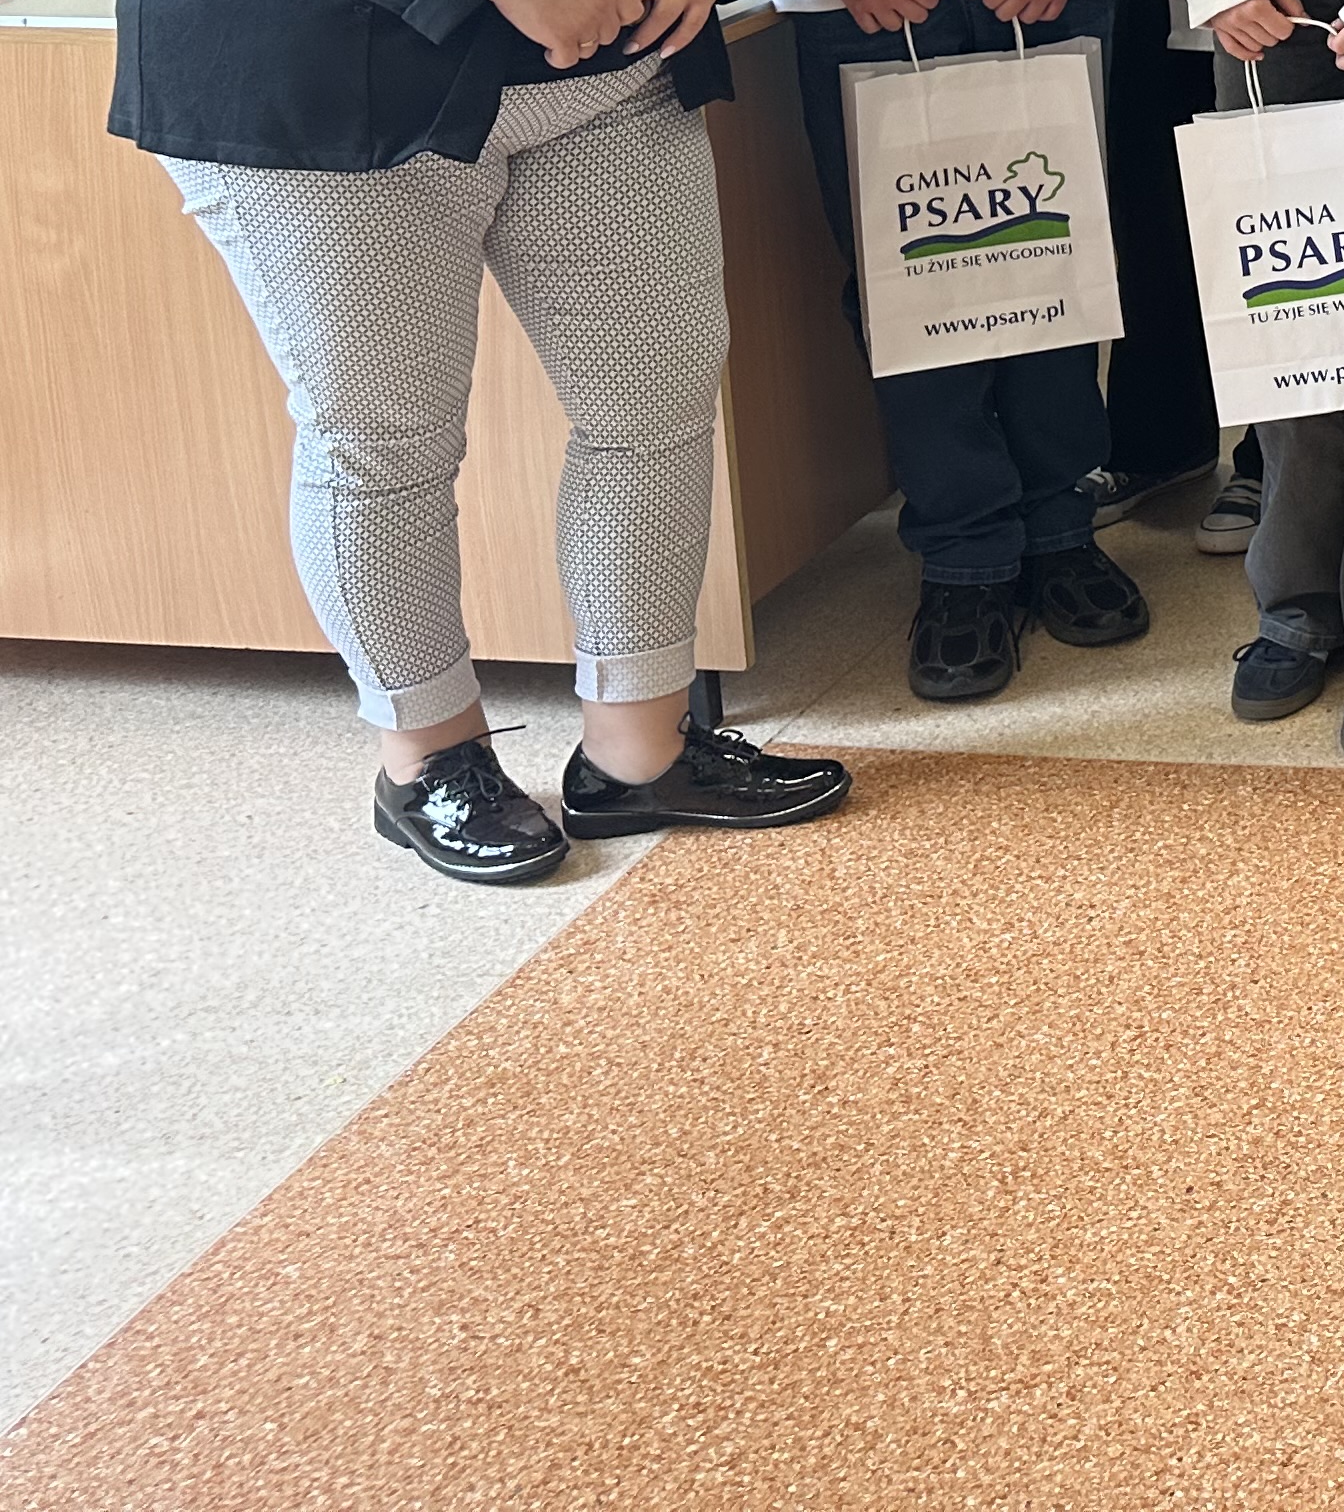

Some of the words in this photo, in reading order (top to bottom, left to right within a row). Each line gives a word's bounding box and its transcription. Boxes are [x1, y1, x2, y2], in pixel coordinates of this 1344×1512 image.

[895, 162, 993, 194] GMINA
[897, 183, 1045, 232] PSARY
[1236, 204, 1336, 235] GMINA
[904, 263, 924, 277] TU
[927, 256, 958, 274] ŻYJE
[961, 254, 982, 270] SIĘ
[985, 243, 1073, 265] WYGODNIEJ
[924, 299, 1066, 336] www.psary.pl
[1248, 312, 1269, 325] TU
[1274, 305, 1305, 323] ŻYJE
[1308, 301, 1330, 316] SIĘ
